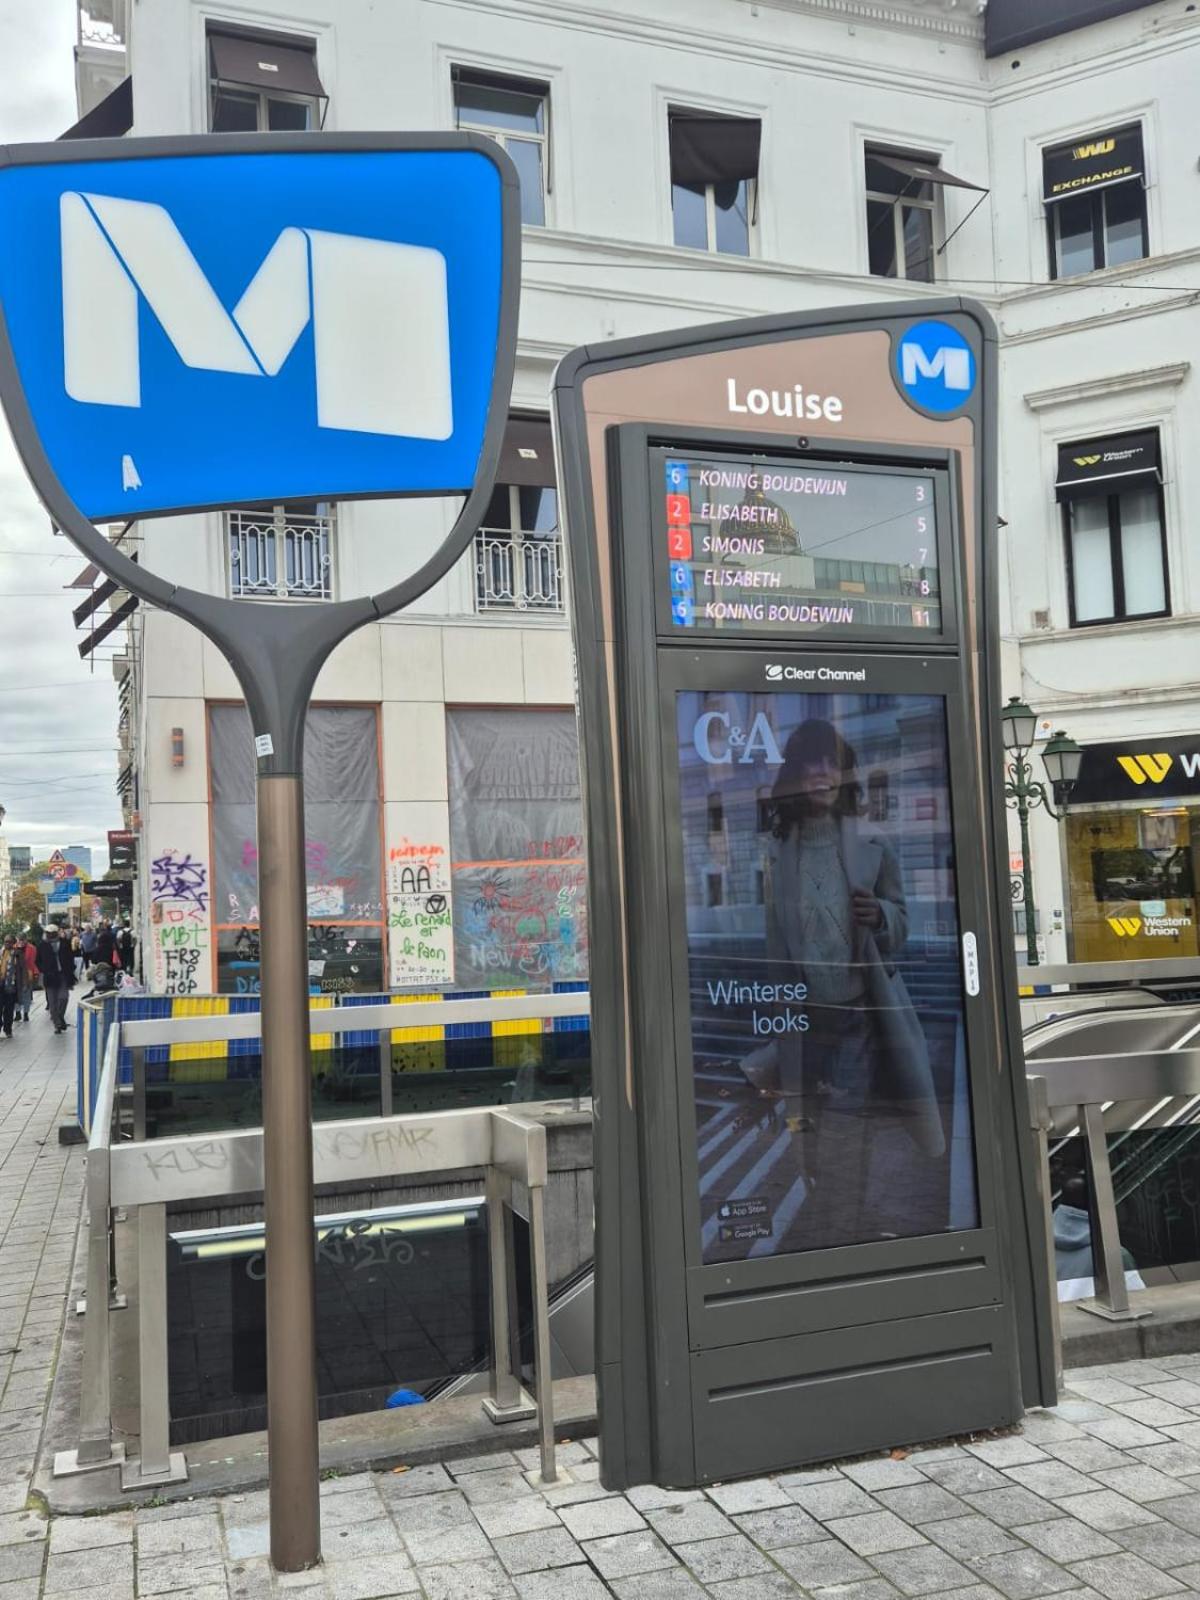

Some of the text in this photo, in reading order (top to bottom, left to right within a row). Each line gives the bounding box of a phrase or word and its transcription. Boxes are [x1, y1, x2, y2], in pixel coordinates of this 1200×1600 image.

[1053, 166, 1133, 192] EXCHANGE
[59, 190, 453, 441] M
[901, 341, 970, 391] M
[727, 378, 843, 422] Louise
[670, 467, 925, 501] 6 KONING BOUDEWIJN 3
[673, 501, 927, 532] 2 ELISABETH 5
[674, 534, 928, 564] 2 SIMONIS 7
[675, 568, 930, 595] 6 ELISABETH 8
[676, 601, 930, 626] 6 KONING BOUDEWIJN 11
[784, 666, 866, 681] Clear Channel
[693, 712, 786, 765] C&A
[1144, 917, 1192, 927] Western
[1144, 926, 1179, 937] Union
[707, 979, 808, 1005] Winterse
[752, 1008, 810, 1035] looks
[733, 1208, 747, 1217] App
[734, 1230, 757, 1239] Google
[757, 1227, 771, 1236] Play
